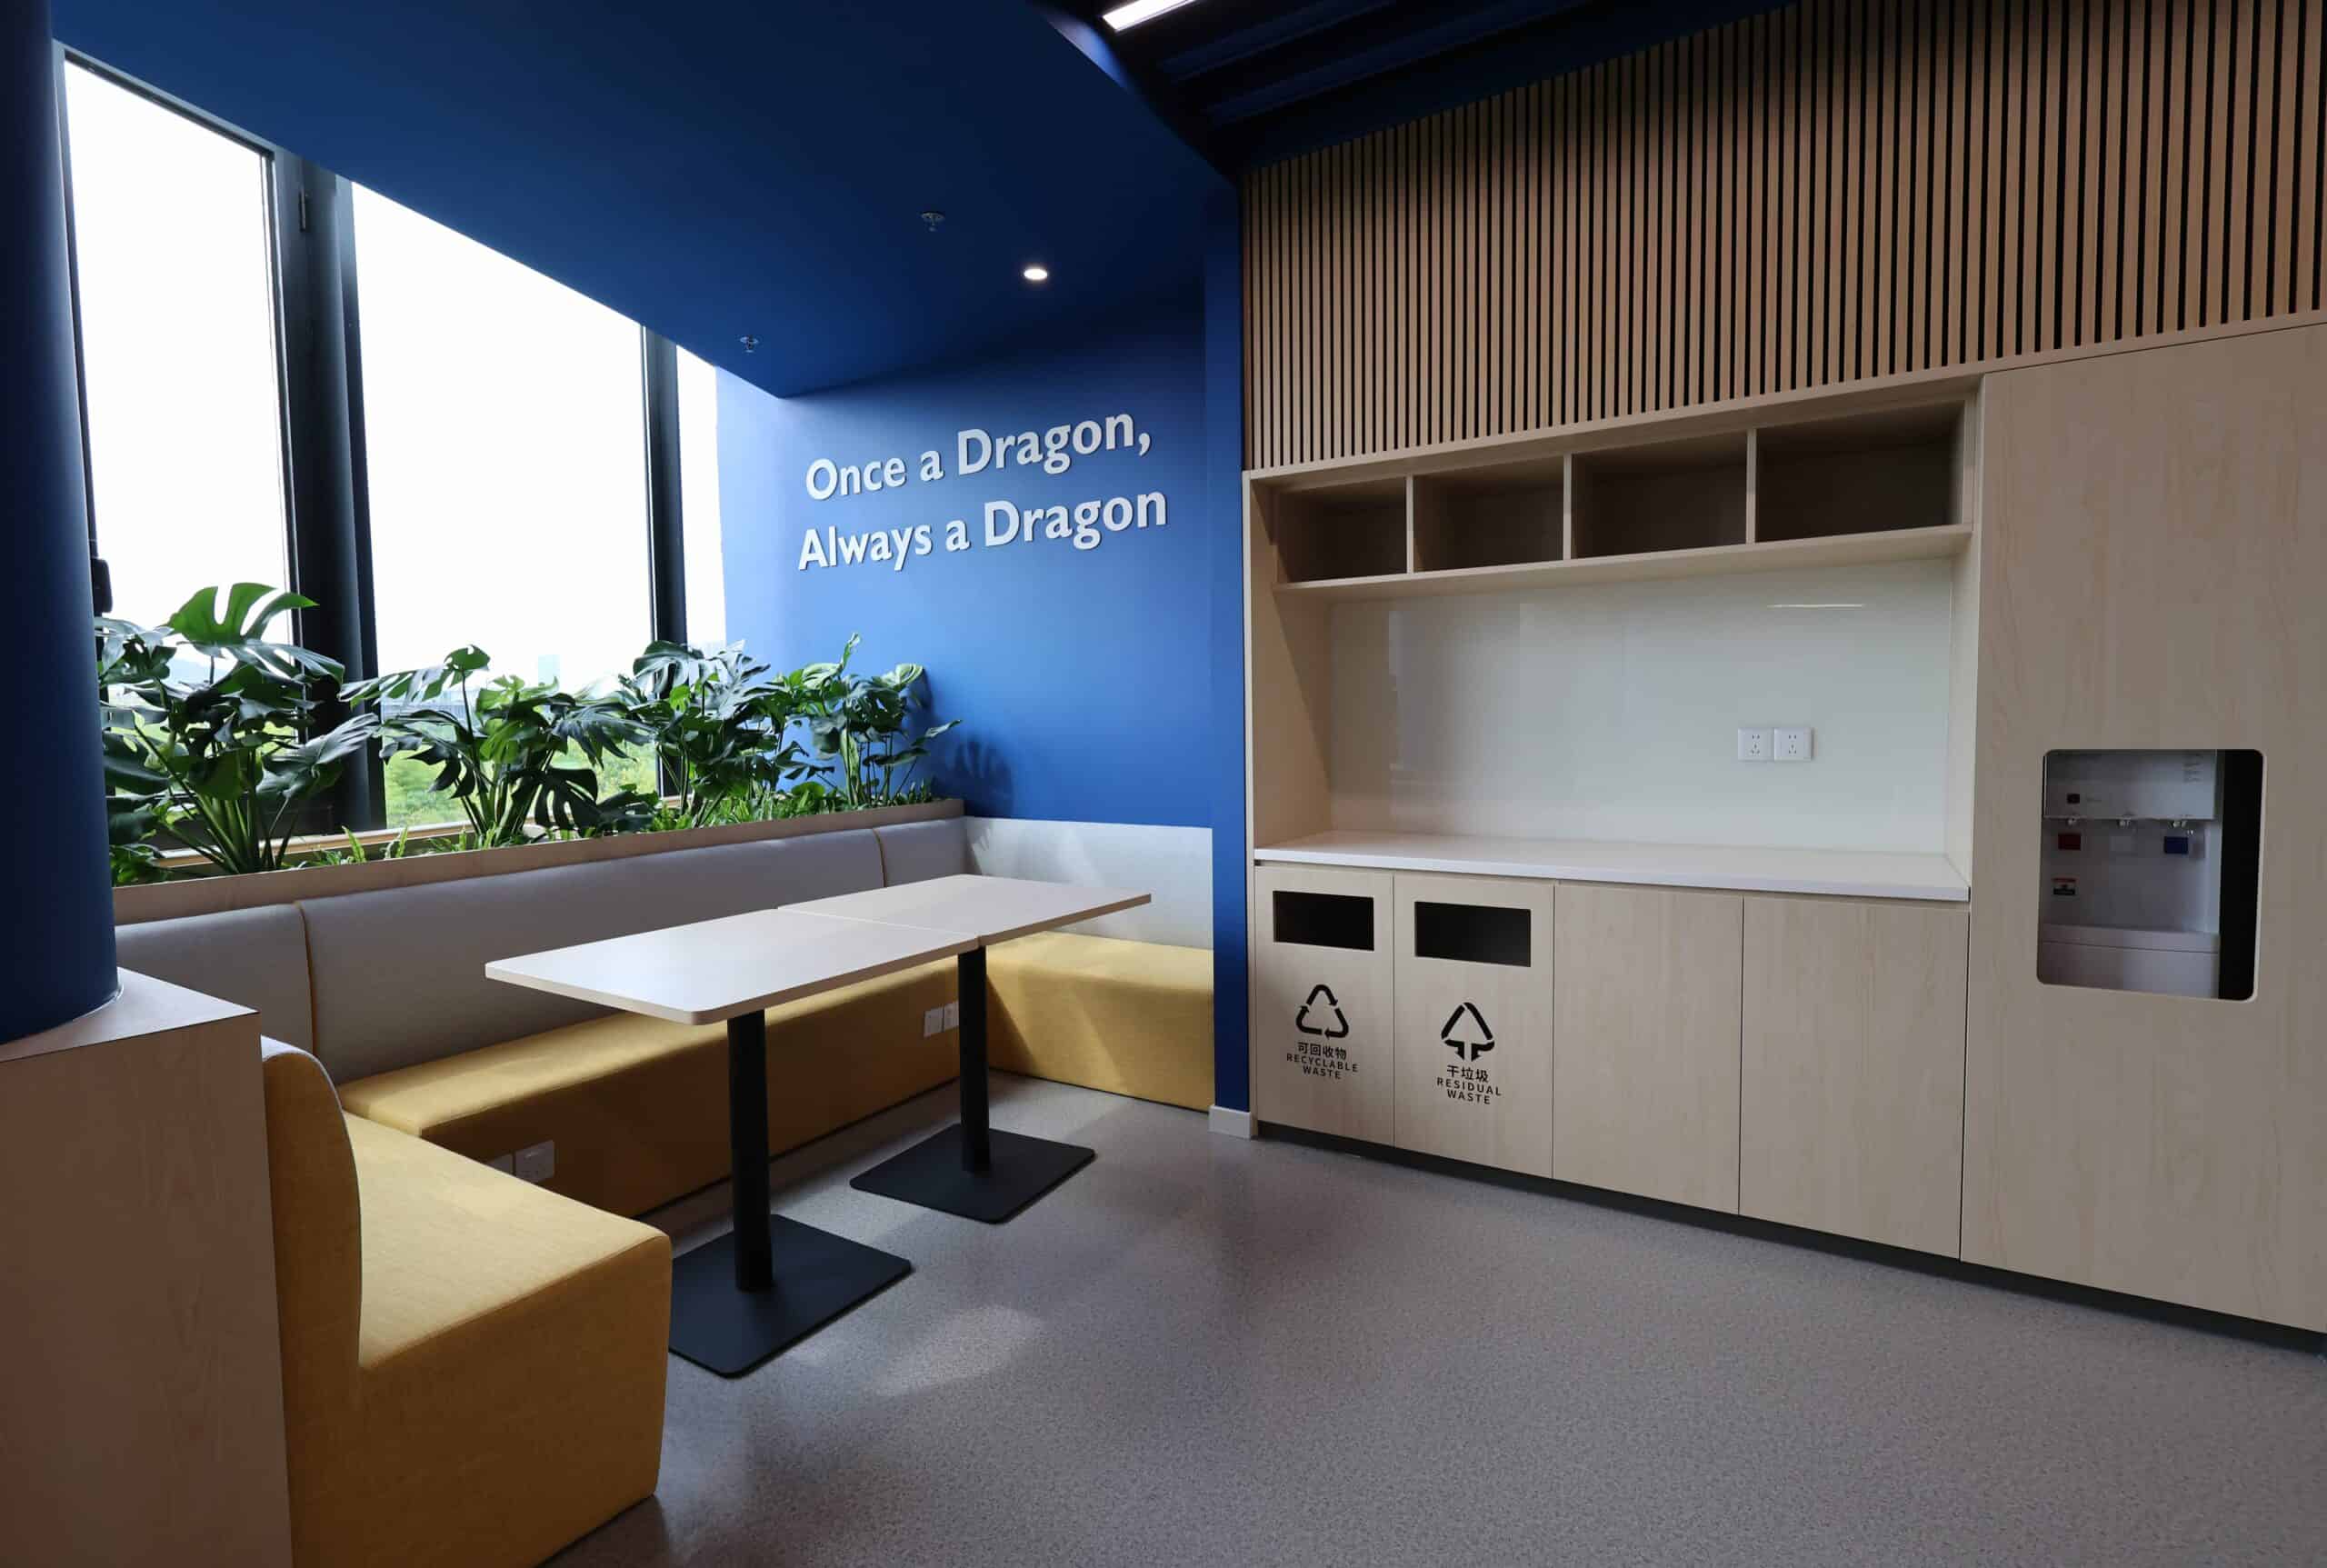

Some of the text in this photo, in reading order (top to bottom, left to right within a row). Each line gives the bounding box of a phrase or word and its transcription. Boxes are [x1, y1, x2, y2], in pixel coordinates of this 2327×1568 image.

[805, 412, 1152, 500] Once a Dragon,
[798, 491, 1167, 571] Always a Dragon
[1297, 1042, 1346, 1060] 可回收物
[1286, 1054, 1358, 1072] RECYCLABLE
[1303, 1065, 1341, 1079] WASTE
[1446, 1064, 1489, 1084] 干垃圾
[1436, 1076, 1502, 1096] RESIDUAL
[1447, 1089, 1490, 1104] WASTE
